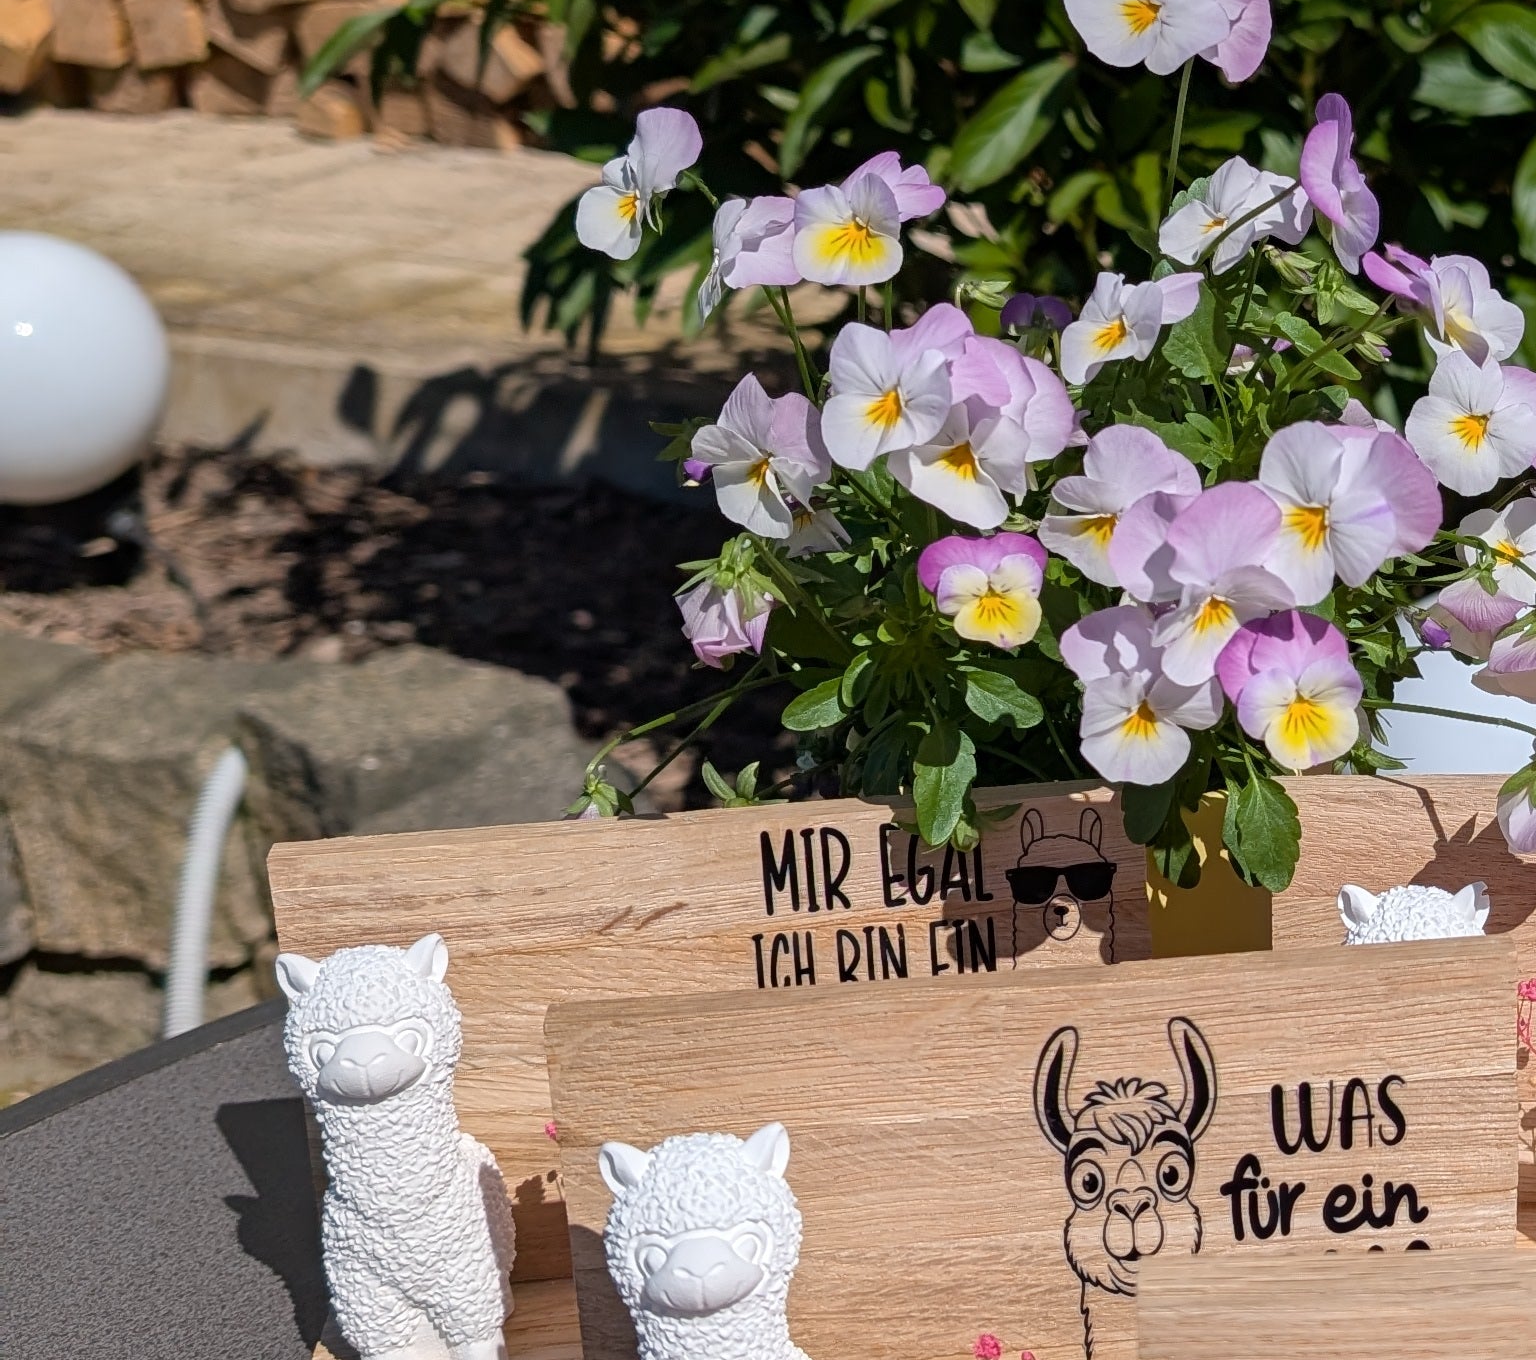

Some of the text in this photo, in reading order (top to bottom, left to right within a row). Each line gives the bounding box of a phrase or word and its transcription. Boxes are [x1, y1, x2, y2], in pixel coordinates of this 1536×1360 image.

[760, 823, 994, 916] MIR EGAL
[752, 931, 816, 988] ICH
[1270, 1075, 1407, 1155] WAS
[1220, 1153, 1430, 1241] für ein
